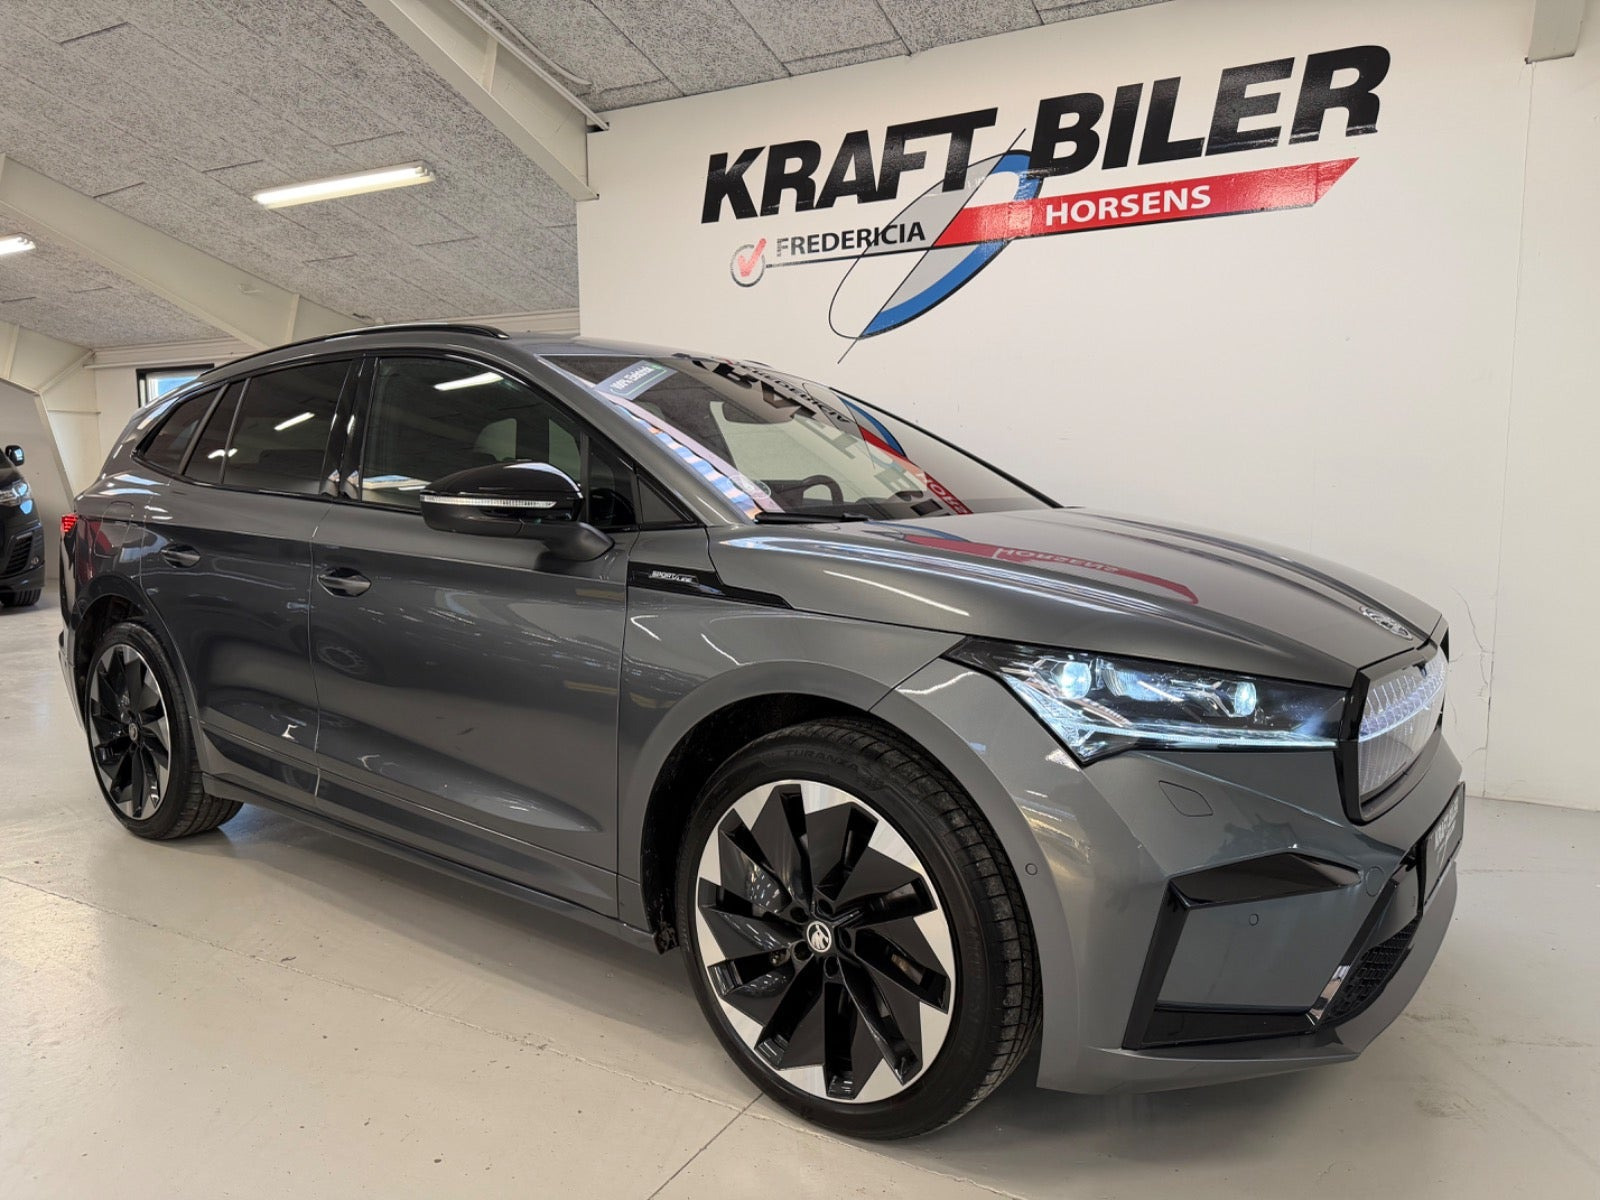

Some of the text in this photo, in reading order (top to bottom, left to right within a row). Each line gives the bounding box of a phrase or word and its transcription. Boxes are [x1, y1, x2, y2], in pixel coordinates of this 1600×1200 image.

[701, 44, 1391, 224] KRAFT BILER
[776, 184, 1212, 257] FREDERICIA HORSENS
